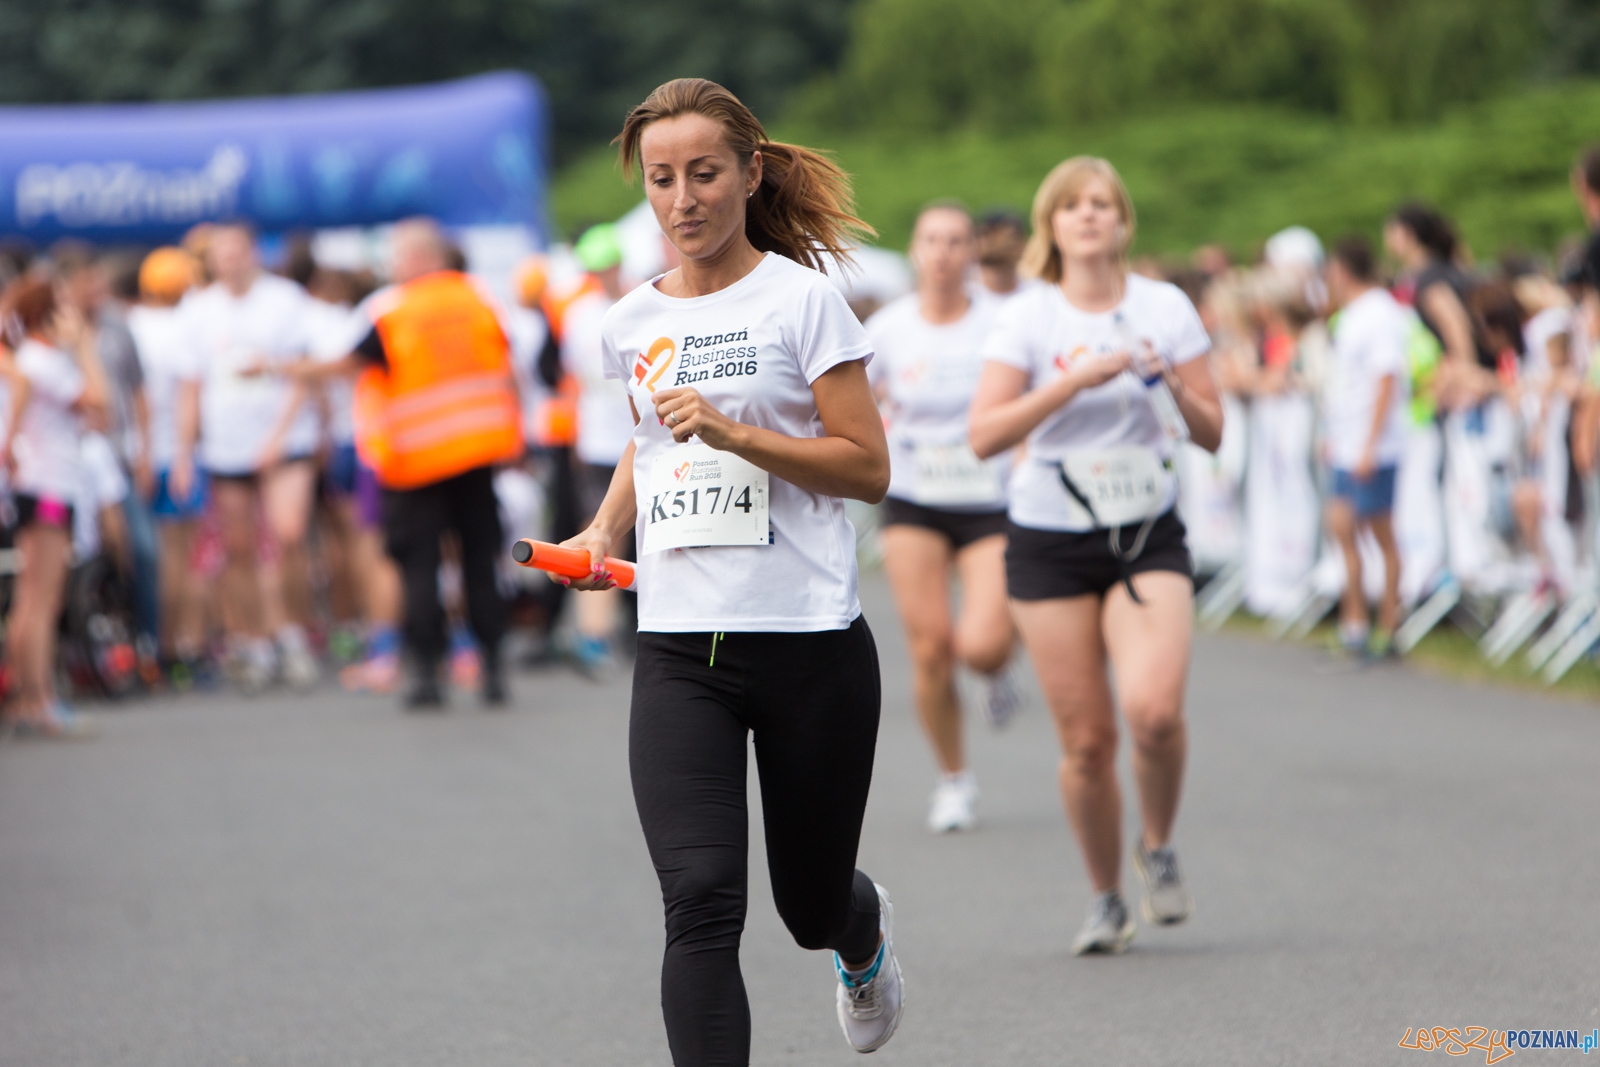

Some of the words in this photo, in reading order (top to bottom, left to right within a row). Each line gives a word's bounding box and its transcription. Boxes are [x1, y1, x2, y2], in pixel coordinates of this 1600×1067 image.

[682, 327, 748, 351] Poznań
[678, 346, 757, 369] Business
[674, 370, 709, 386] Run
[712, 360, 758, 379] 2016
[704, 472, 722, 480] 2016
[650, 485, 753, 524] K517/4
